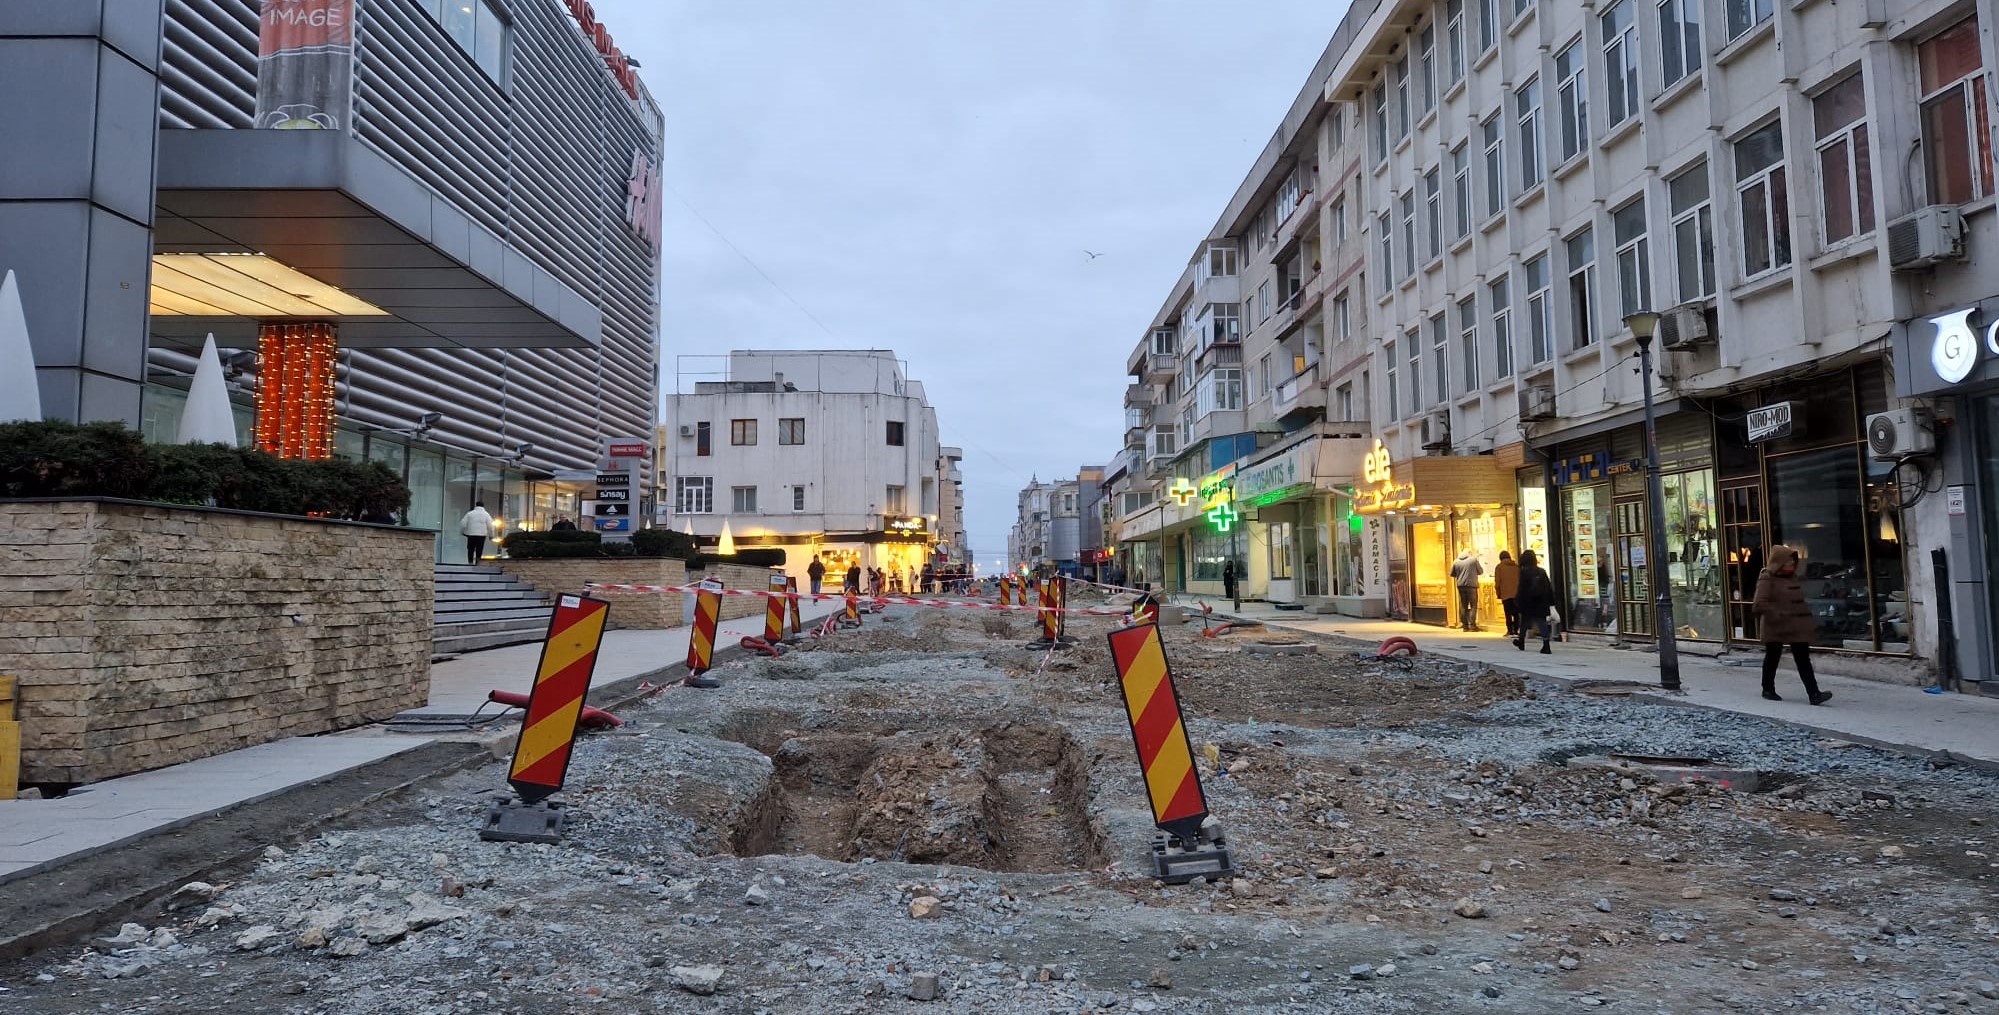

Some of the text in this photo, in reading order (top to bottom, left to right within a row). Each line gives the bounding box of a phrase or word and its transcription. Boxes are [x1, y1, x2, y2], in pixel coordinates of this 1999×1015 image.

[270, 8, 342, 26] IMAGE
[1945, 335, 1960, 359] G
[1750, 407, 1788, 430] NIRO-MOD
[1607, 463, 1632, 474] CENTER
[600, 490, 626, 499] sinsay
[1372, 530, 1380, 586] FARMACIE
